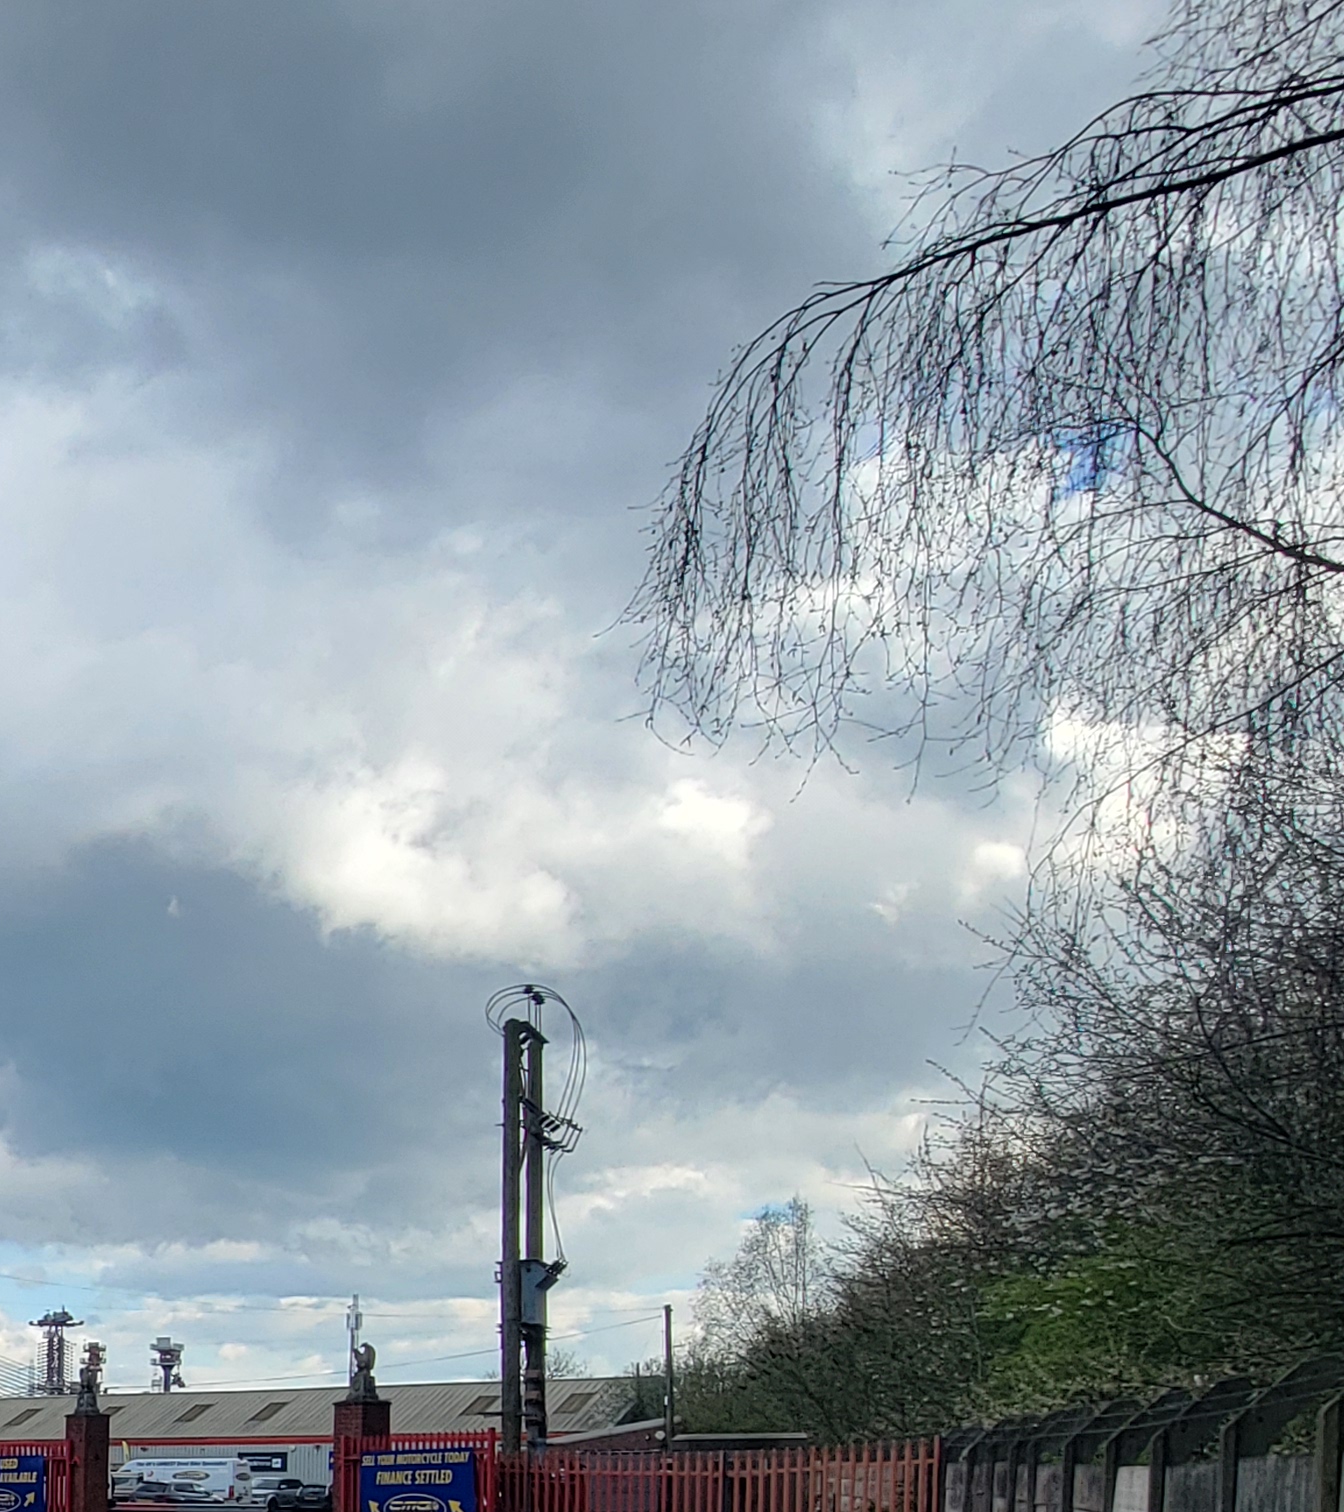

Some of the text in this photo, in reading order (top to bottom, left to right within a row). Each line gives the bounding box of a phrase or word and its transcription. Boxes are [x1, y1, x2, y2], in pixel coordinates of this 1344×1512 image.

[395, 1453, 443, 1465] MOTORCYCLE
[444, 1451, 470, 1463] TODAY
[0, 1471, 38, 1483] AVAILABLE
[376, 1469, 453, 1485] FINANCE SETTLED
